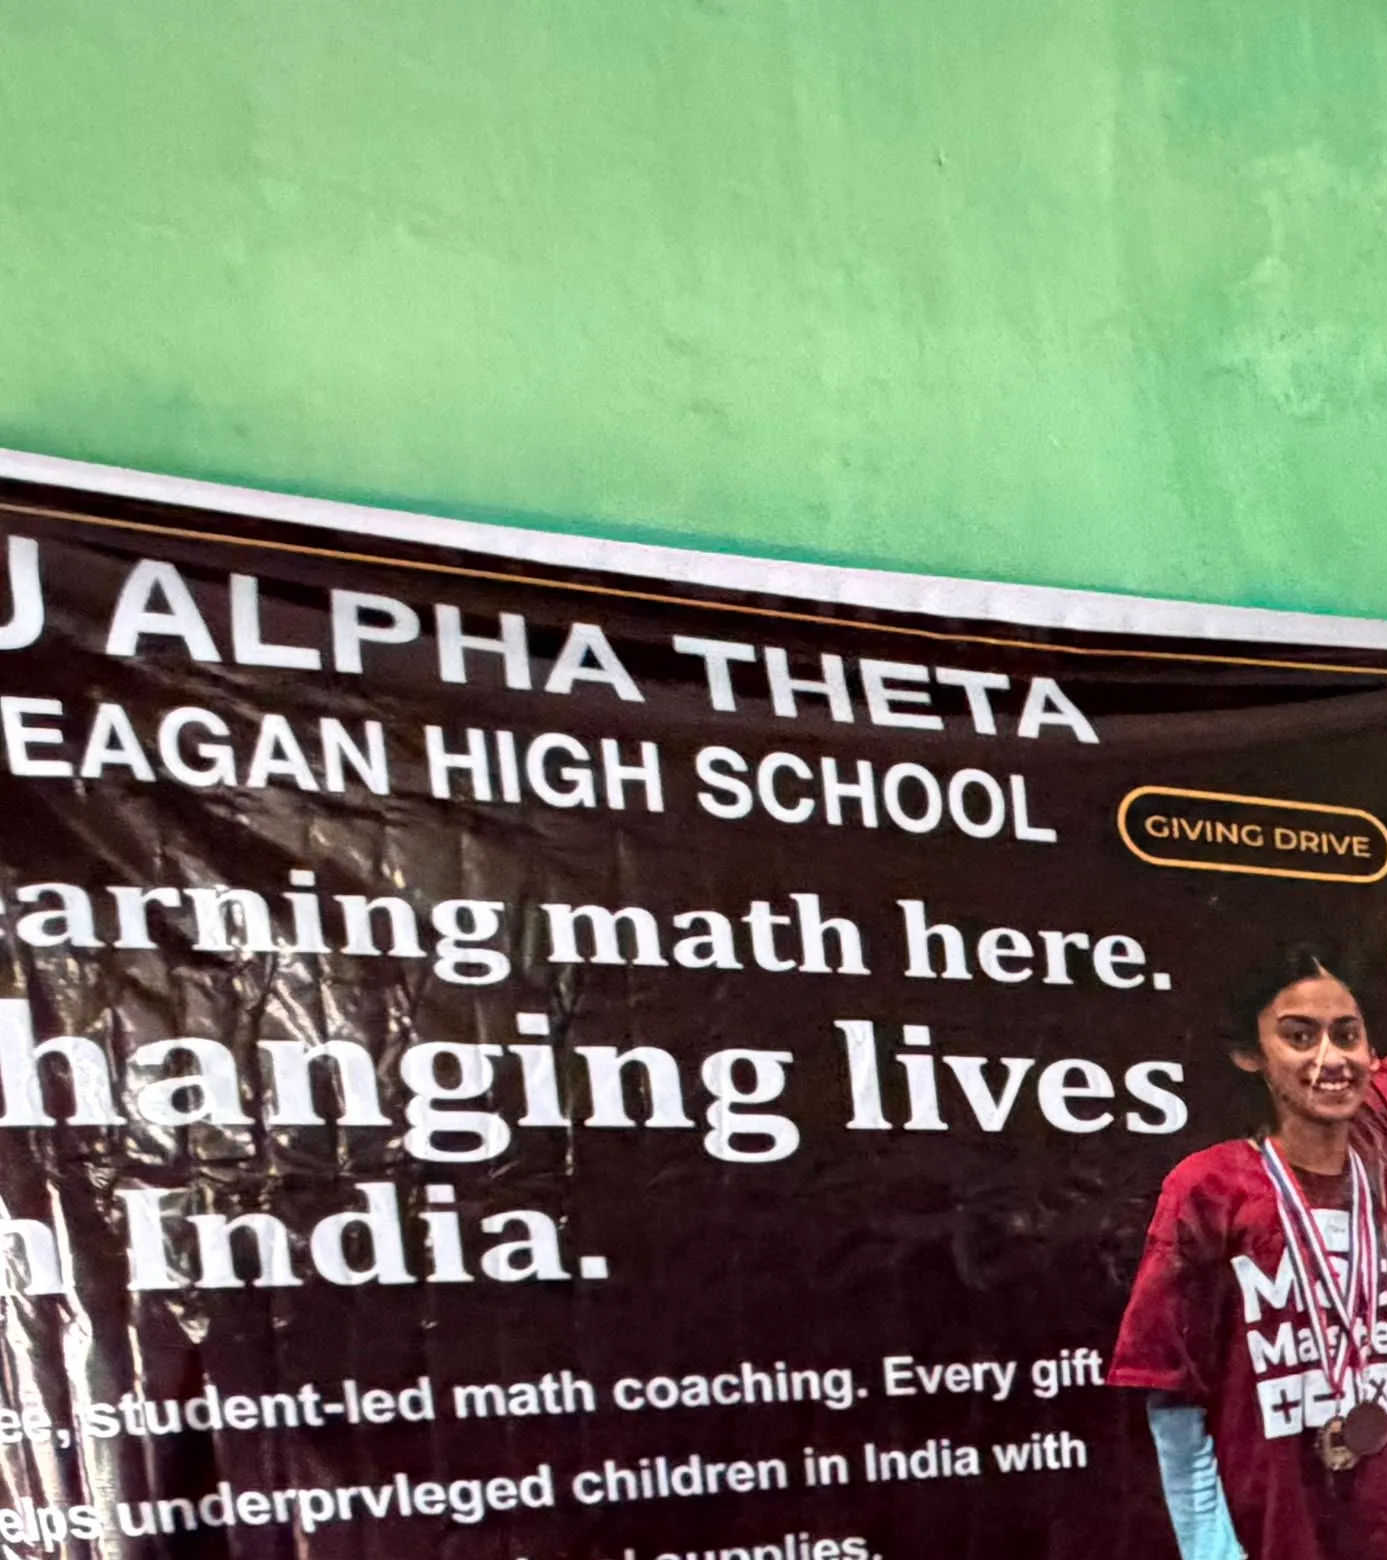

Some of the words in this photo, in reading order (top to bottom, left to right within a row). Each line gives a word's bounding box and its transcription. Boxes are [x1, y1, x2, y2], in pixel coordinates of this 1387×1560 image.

[106, 559, 646, 702] ALPHA
[672, 635, 1099, 744] THETA
[0, 696, 390, 796] EAGAN
[424, 725, 664, 812] HIGH
[696, 746, 1057, 843] SCHOOL
[1144, 815, 1264, 848] GIVING
[1274, 827, 1372, 858] DRIVE
[541, 893, 871, 976] math
[897, 899, 1172, 991] here.
[834, 1019, 1189, 1134] lives
[113, 1182, 608, 1292] India.
[86, 1376, 436, 1439] student-led
[455, 1370, 596, 1419] math
[613, 1361, 868, 1411] coaching.
[883, 1355, 1017, 1401] Every
[1031, 1347, 1104, 1398] gift
[117, 1463, 553, 1533] underprvleged
[572, 1454, 789, 1504] children
[803, 1446, 849, 1487] in
[864, 1439, 981, 1483] India
[991, 1431, 1087, 1474] with
